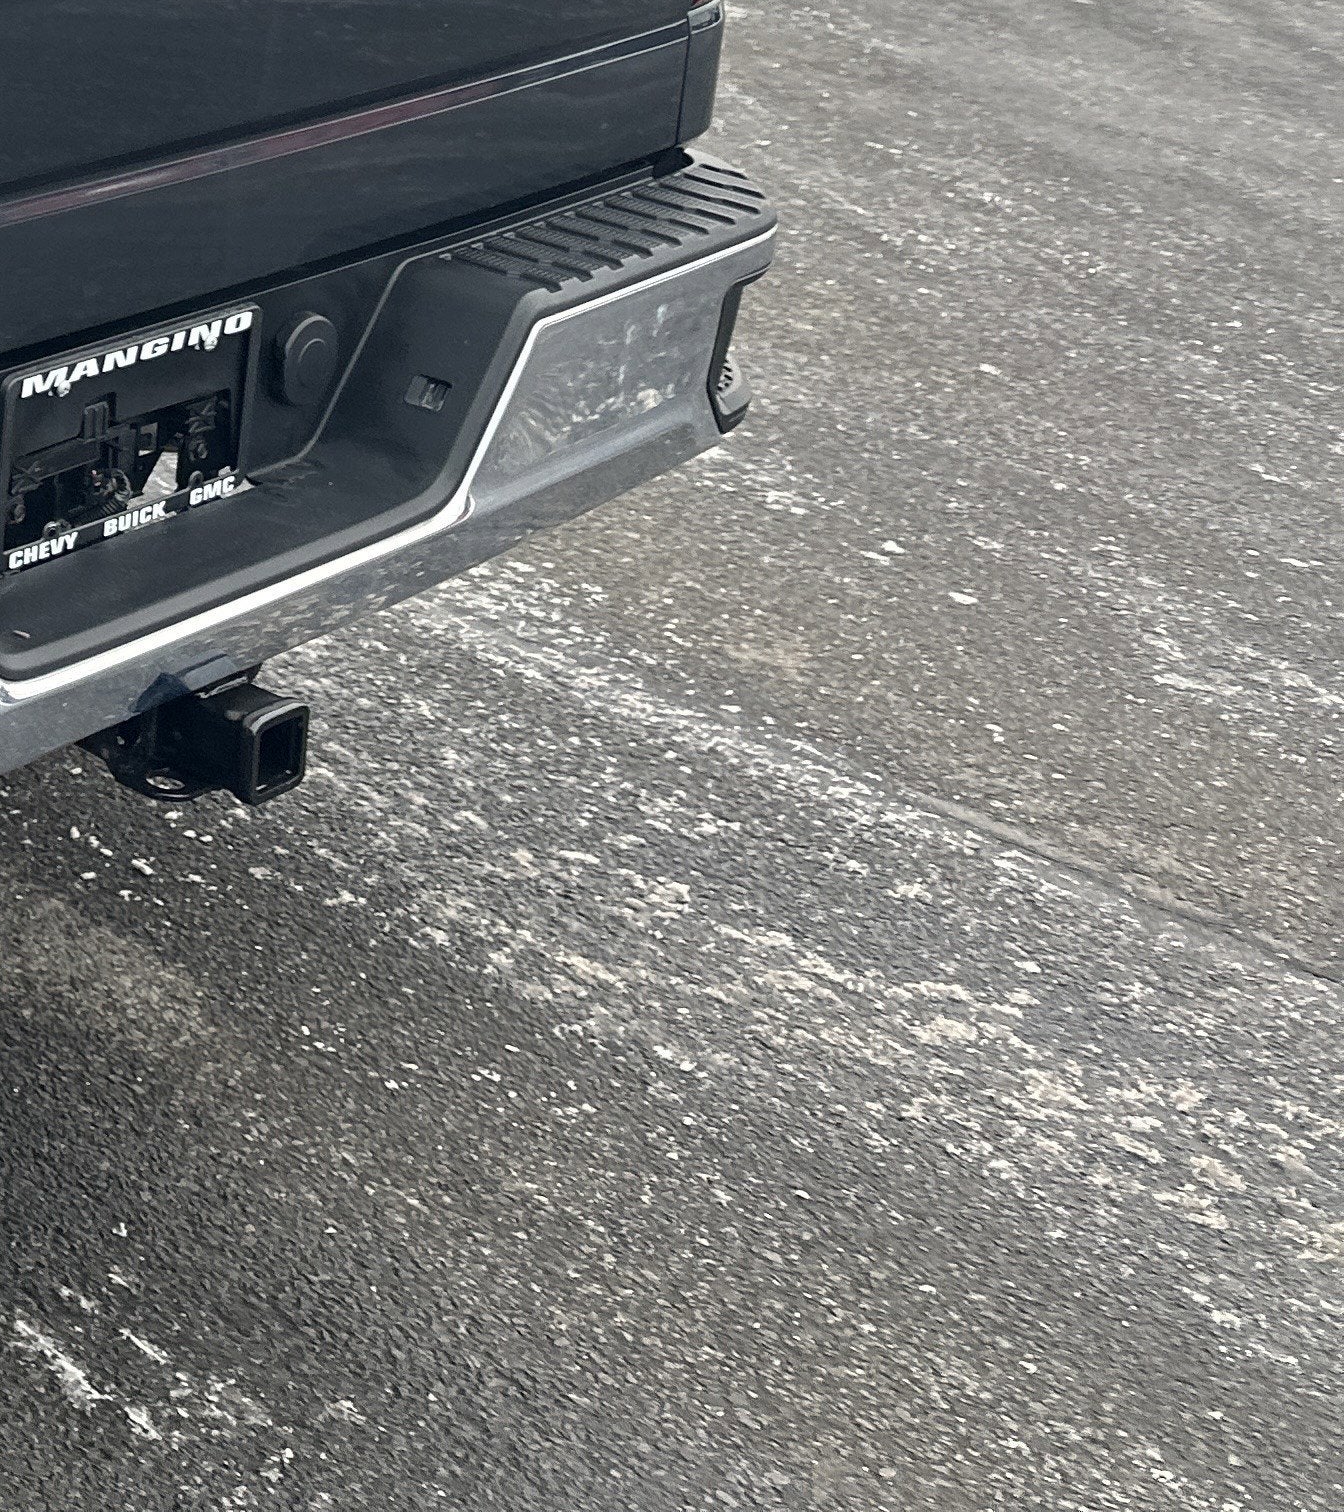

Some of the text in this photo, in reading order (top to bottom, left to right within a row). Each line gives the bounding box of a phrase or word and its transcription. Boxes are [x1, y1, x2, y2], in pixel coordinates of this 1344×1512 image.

[21, 311, 253, 399] MANGINO
[8, 476, 235, 569] CHEVY BUICK GMC
